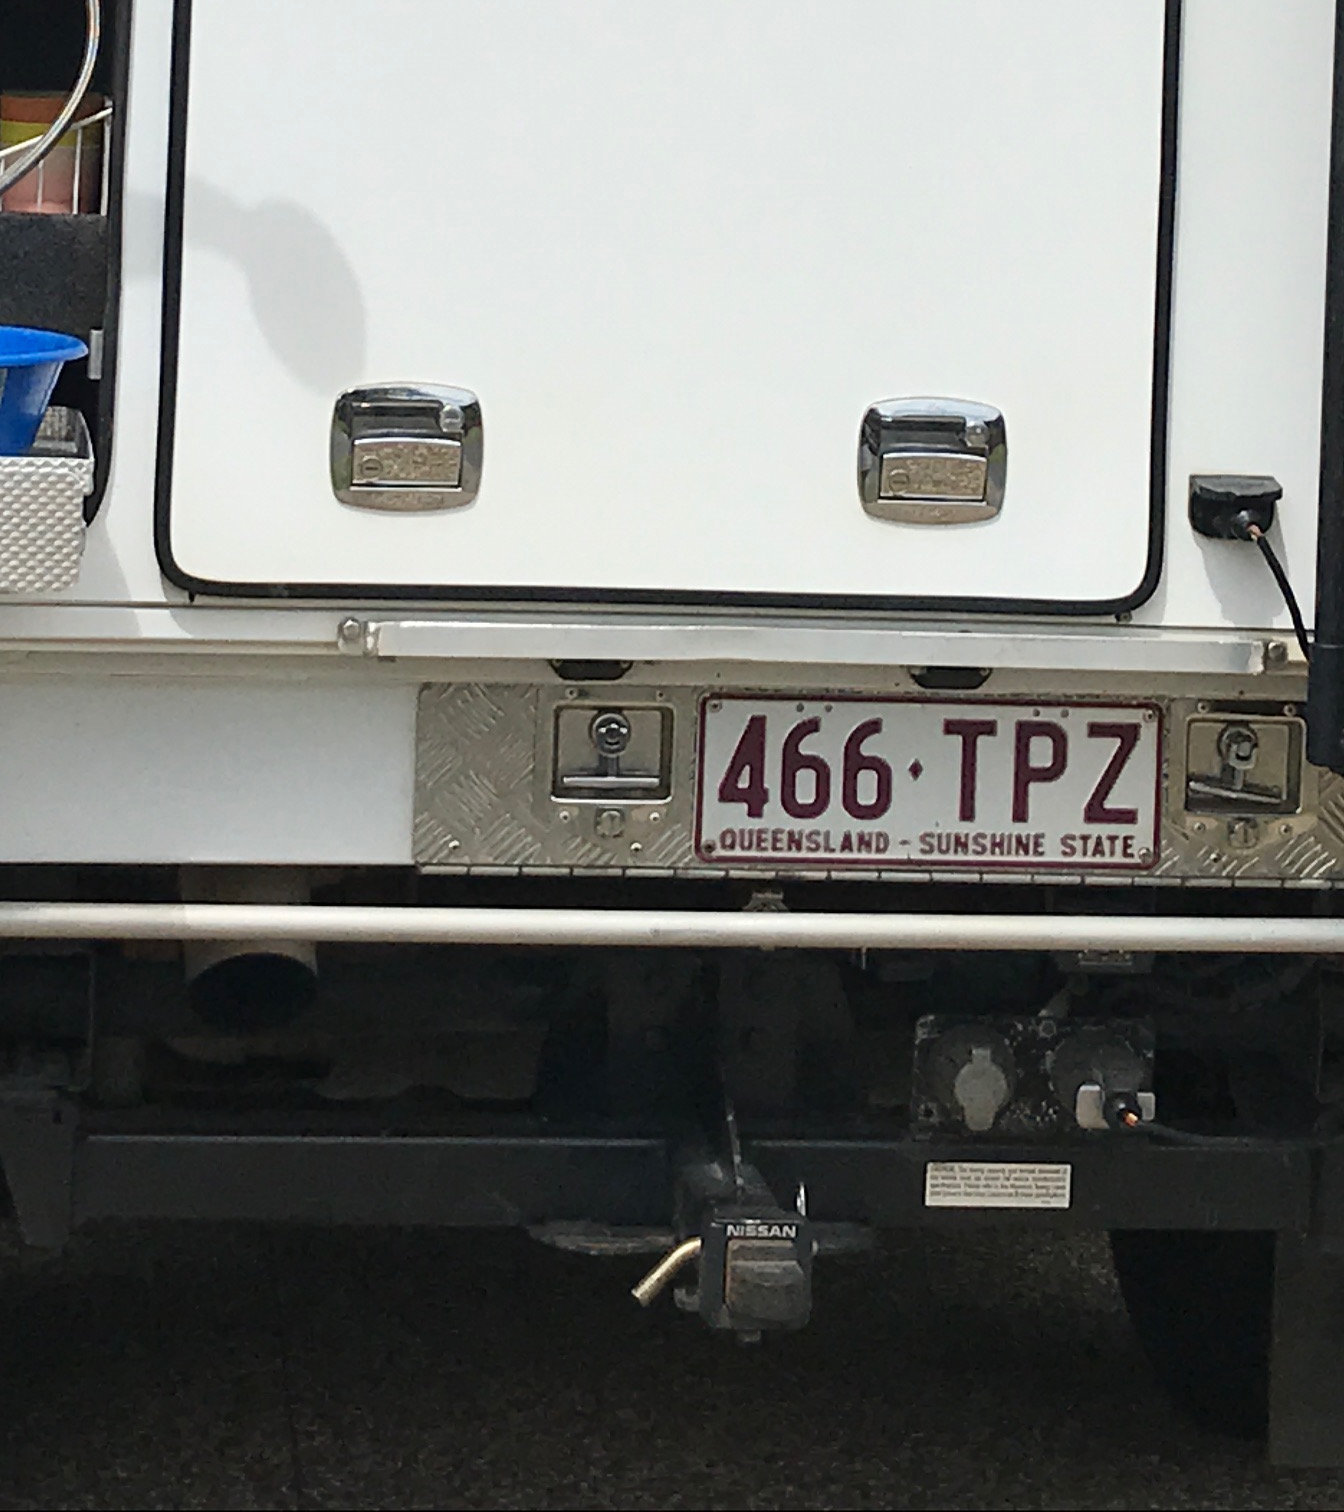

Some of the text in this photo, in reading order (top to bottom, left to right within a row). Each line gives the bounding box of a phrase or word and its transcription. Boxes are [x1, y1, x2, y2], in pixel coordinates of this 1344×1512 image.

[719, 828, 889, 854] QUEENSLAND
[919, 832, 1045, 857] SUNSHINE
[1060, 834, 1135, 859] STATE
[726, 1224, 797, 1238] NISSAN
